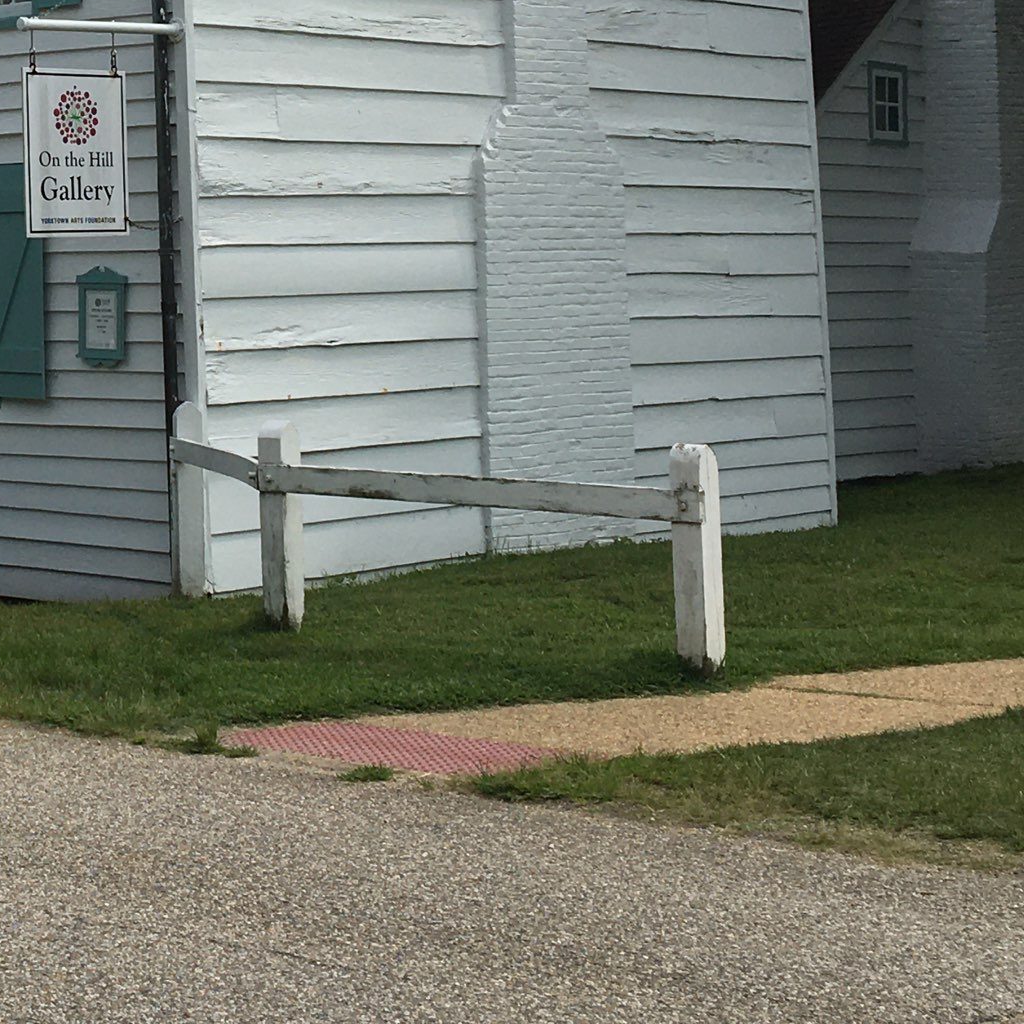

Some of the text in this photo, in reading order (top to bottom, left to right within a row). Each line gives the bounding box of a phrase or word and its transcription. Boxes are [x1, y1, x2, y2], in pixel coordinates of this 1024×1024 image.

[39, 151, 113, 167] On the Hill
[40, 176, 115, 206] Gallery
